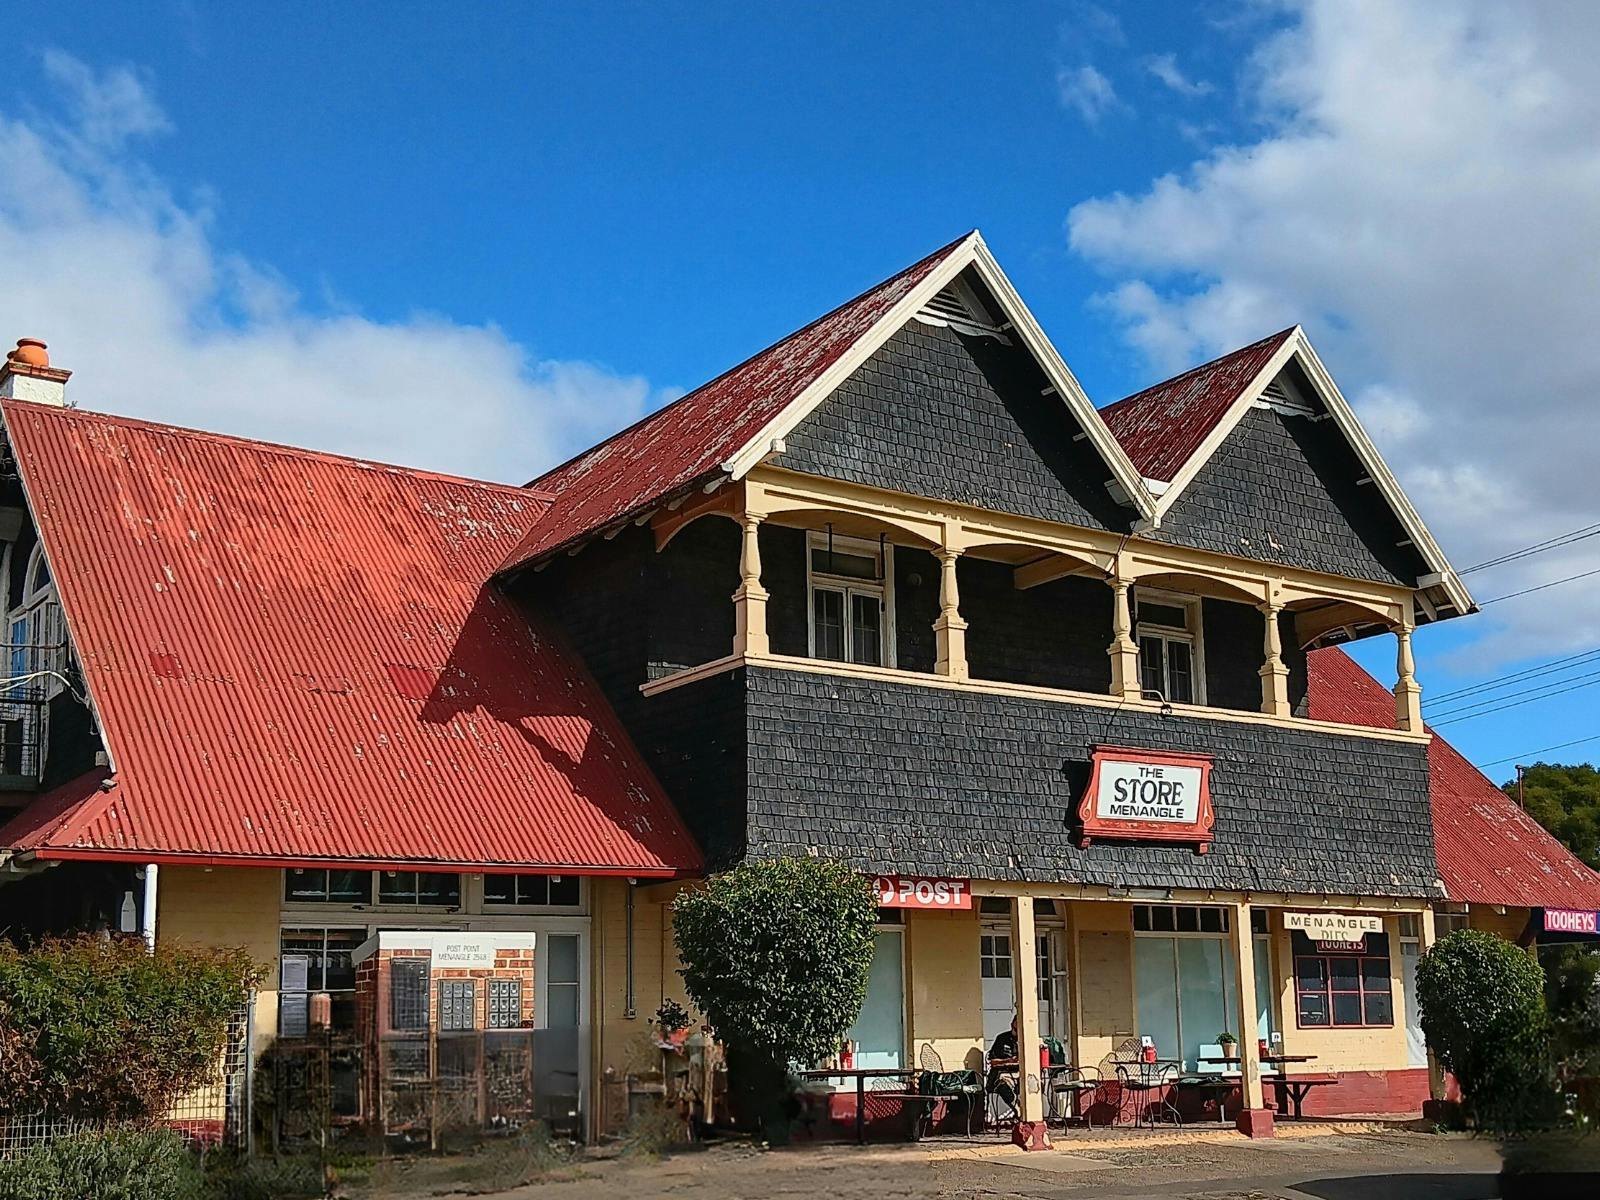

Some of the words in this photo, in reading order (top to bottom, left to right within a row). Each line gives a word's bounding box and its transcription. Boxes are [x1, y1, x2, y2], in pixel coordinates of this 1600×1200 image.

[1138, 766, 1164, 778] THE
[1114, 778, 1184, 806] STORE
[1110, 804, 1184, 818] MENANGLE
[898, 880, 964, 905] POST
[1290, 916, 1377, 930] MENANGLE
[1546, 911, 1595, 931] TOOHEYS
[446, 944, 461, 952] POST
[463, 944, 480, 952] POINT
